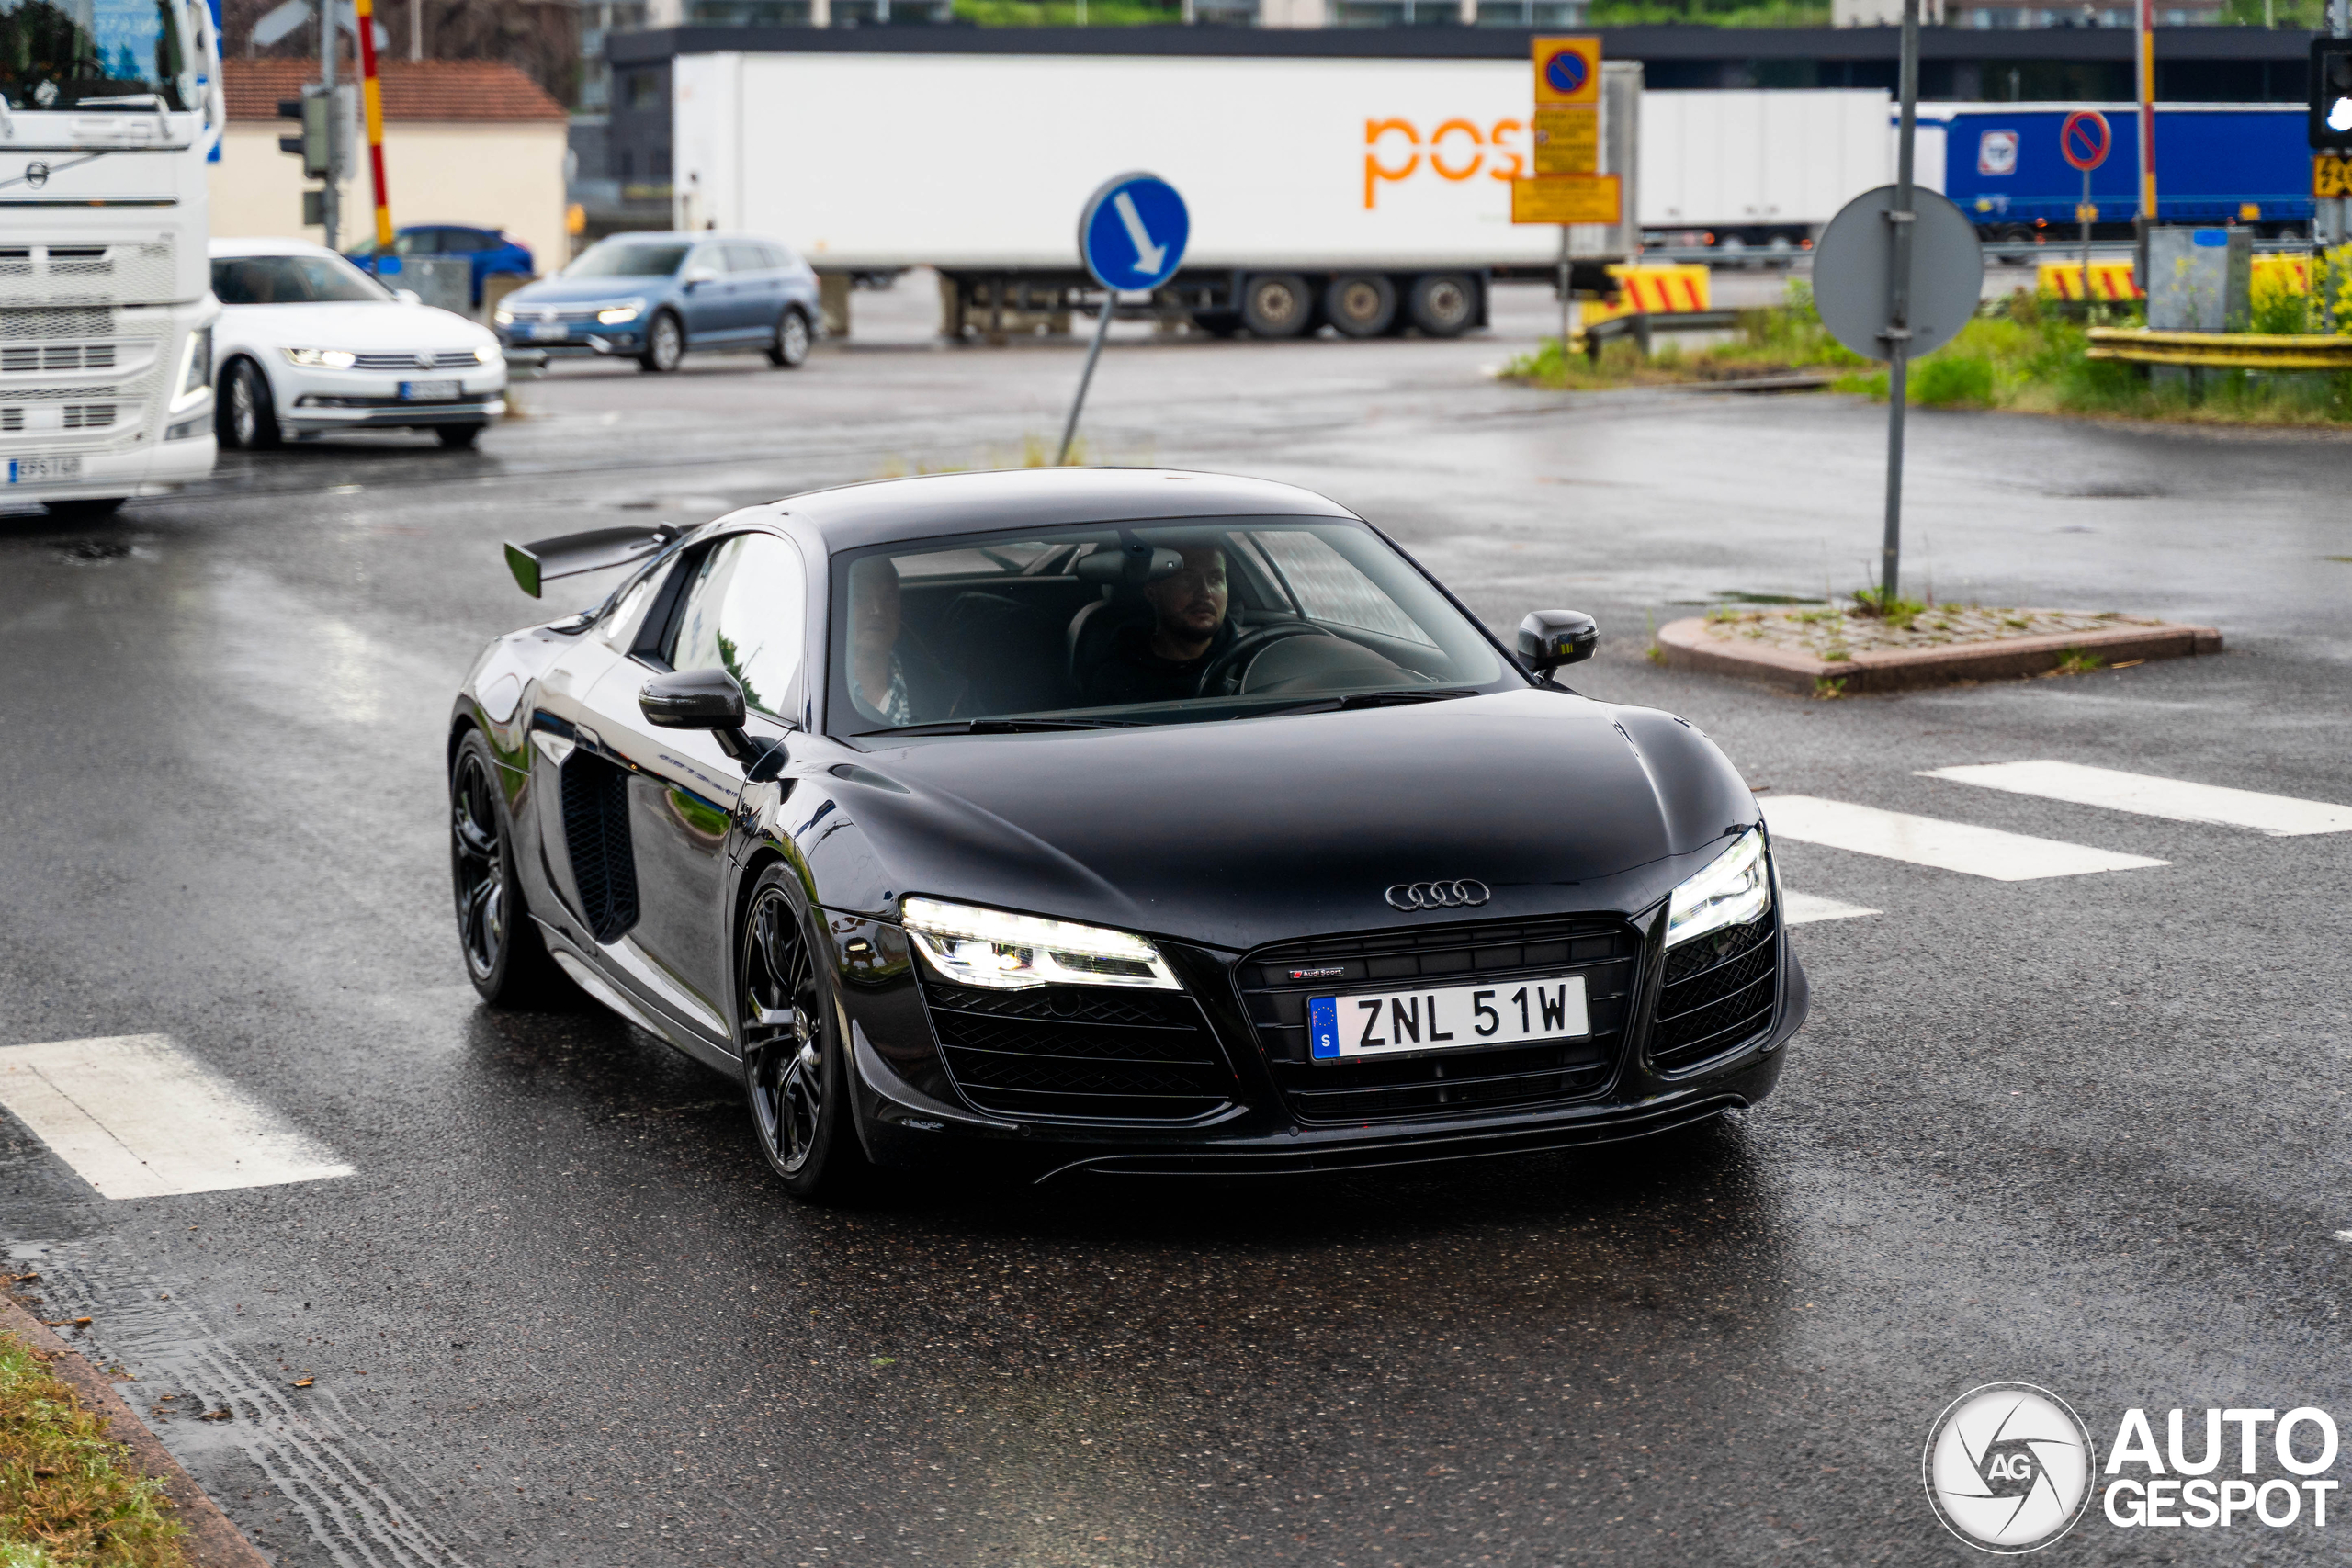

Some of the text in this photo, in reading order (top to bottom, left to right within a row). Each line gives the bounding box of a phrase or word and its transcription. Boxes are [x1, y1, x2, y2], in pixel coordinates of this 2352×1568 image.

[1365, 118, 1535, 209] pos
[1320, 1034, 1331, 1047] S
[1358, 983, 1566, 1047] ZNL 51W
